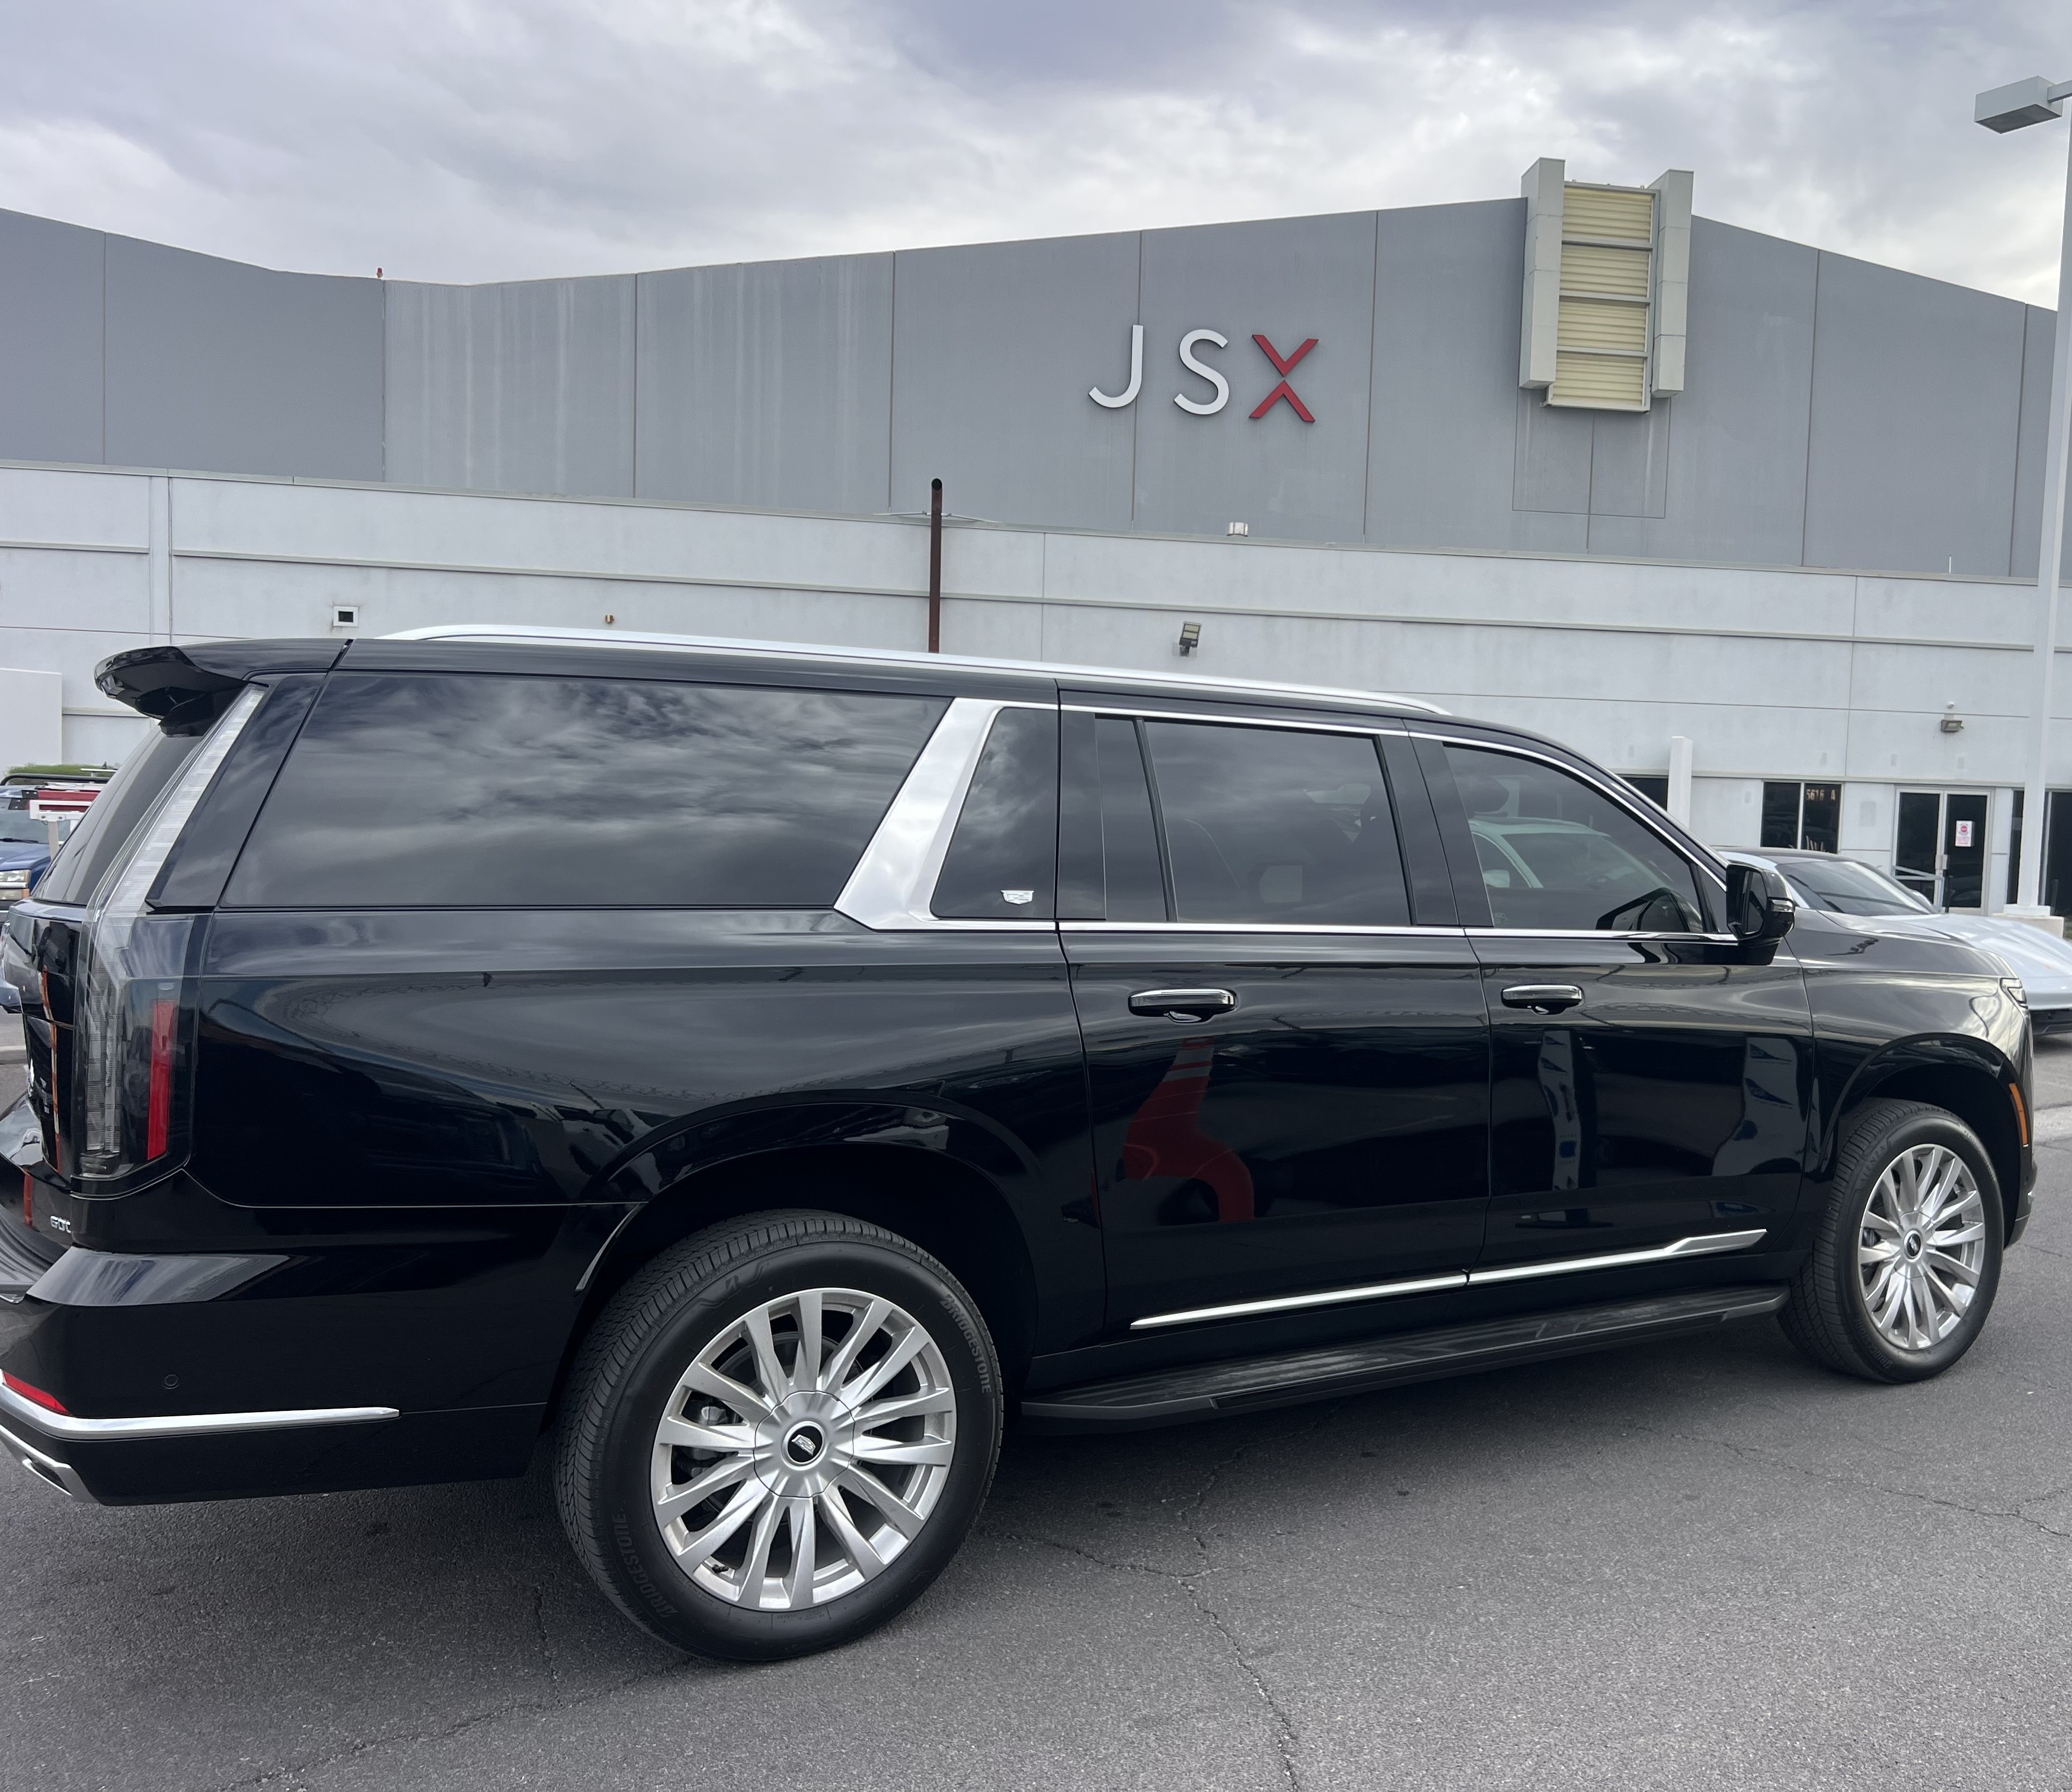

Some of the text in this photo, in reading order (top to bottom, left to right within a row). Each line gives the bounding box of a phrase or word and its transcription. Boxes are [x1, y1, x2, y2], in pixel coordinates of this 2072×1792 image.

[1089, 325, 1319, 423] JSX
[939, 1294, 992, 1394] BRIDGESTONE
[612, 1512, 679, 1618] BRIDGESTONE
